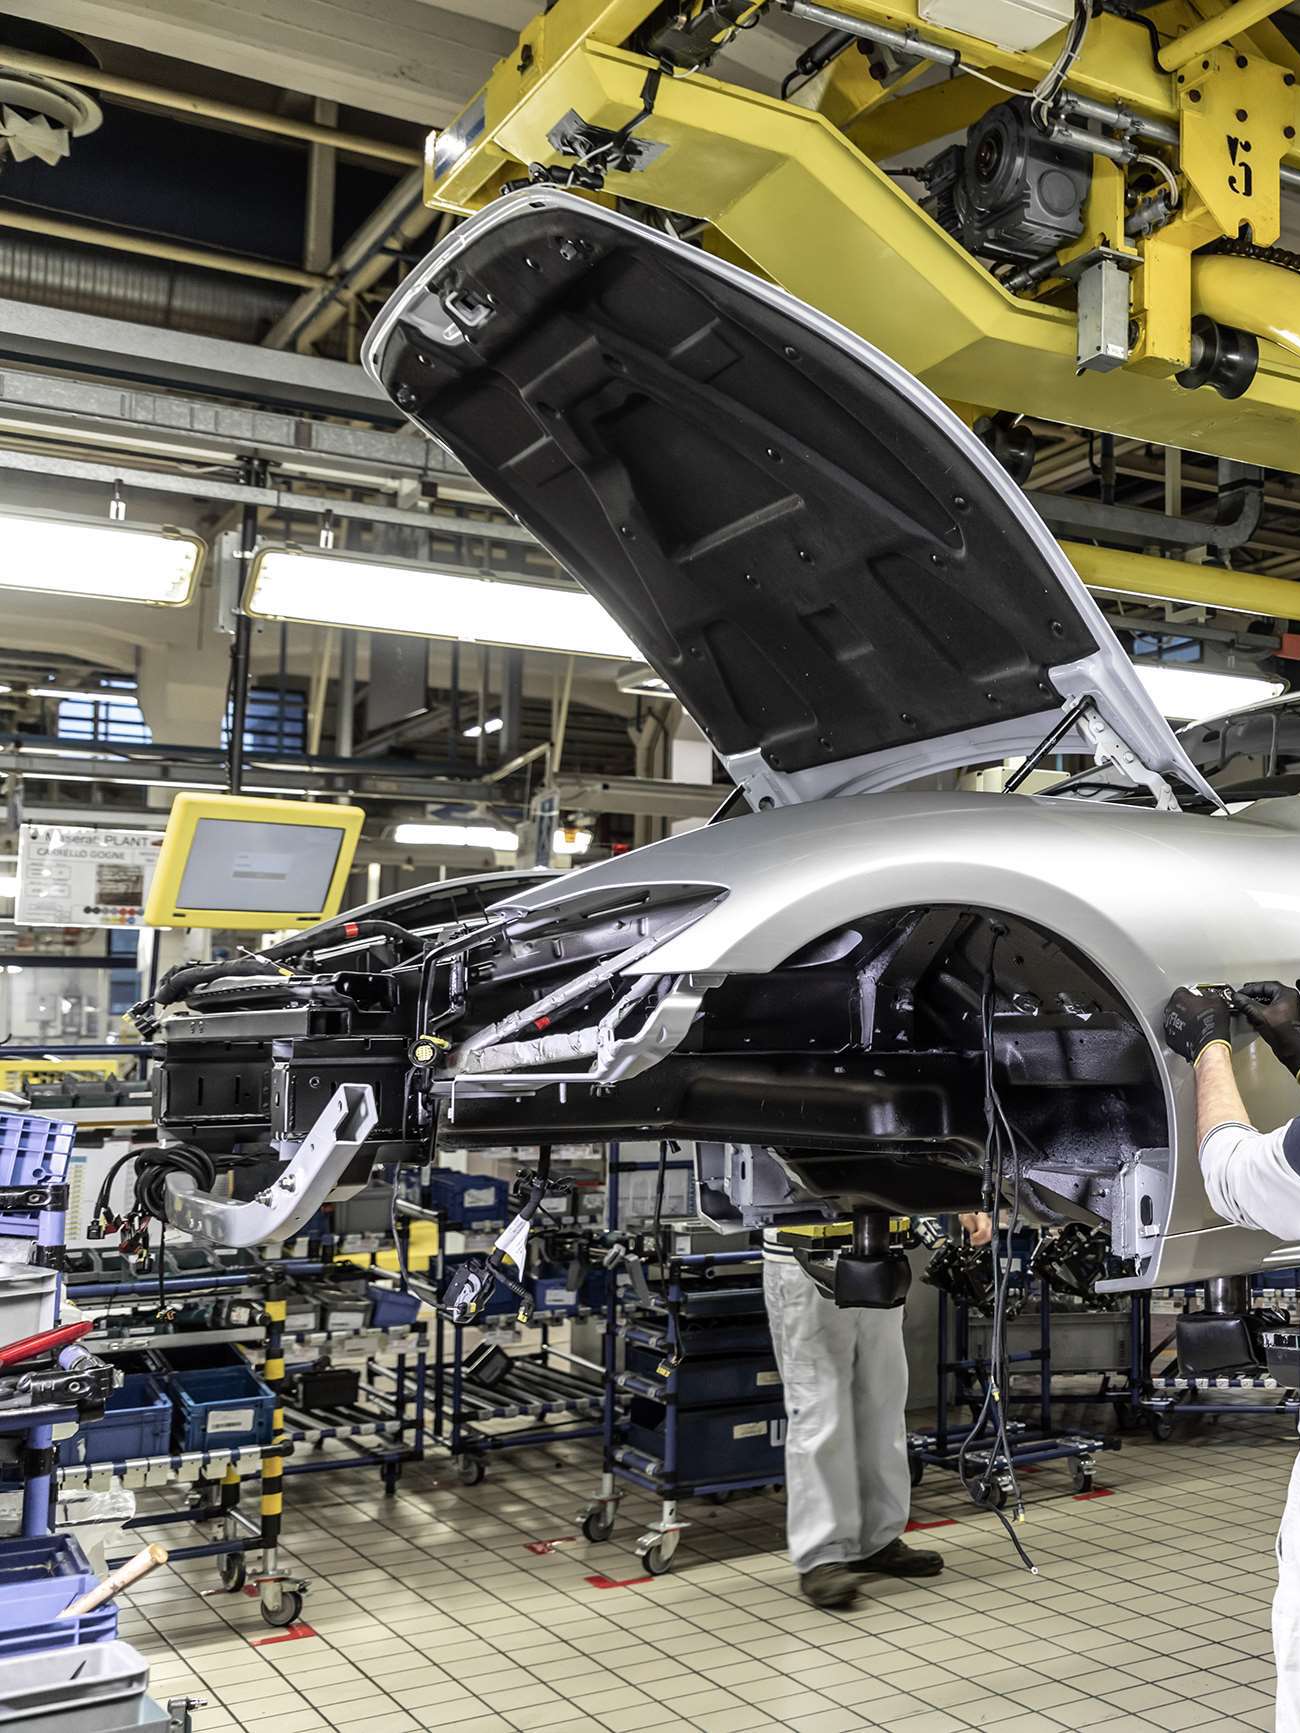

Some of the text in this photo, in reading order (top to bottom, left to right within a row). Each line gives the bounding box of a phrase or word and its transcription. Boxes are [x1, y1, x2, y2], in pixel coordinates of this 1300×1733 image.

[1226, 134, 1253, 197] 5
[45, 832, 149, 847] Mserat PLANT
